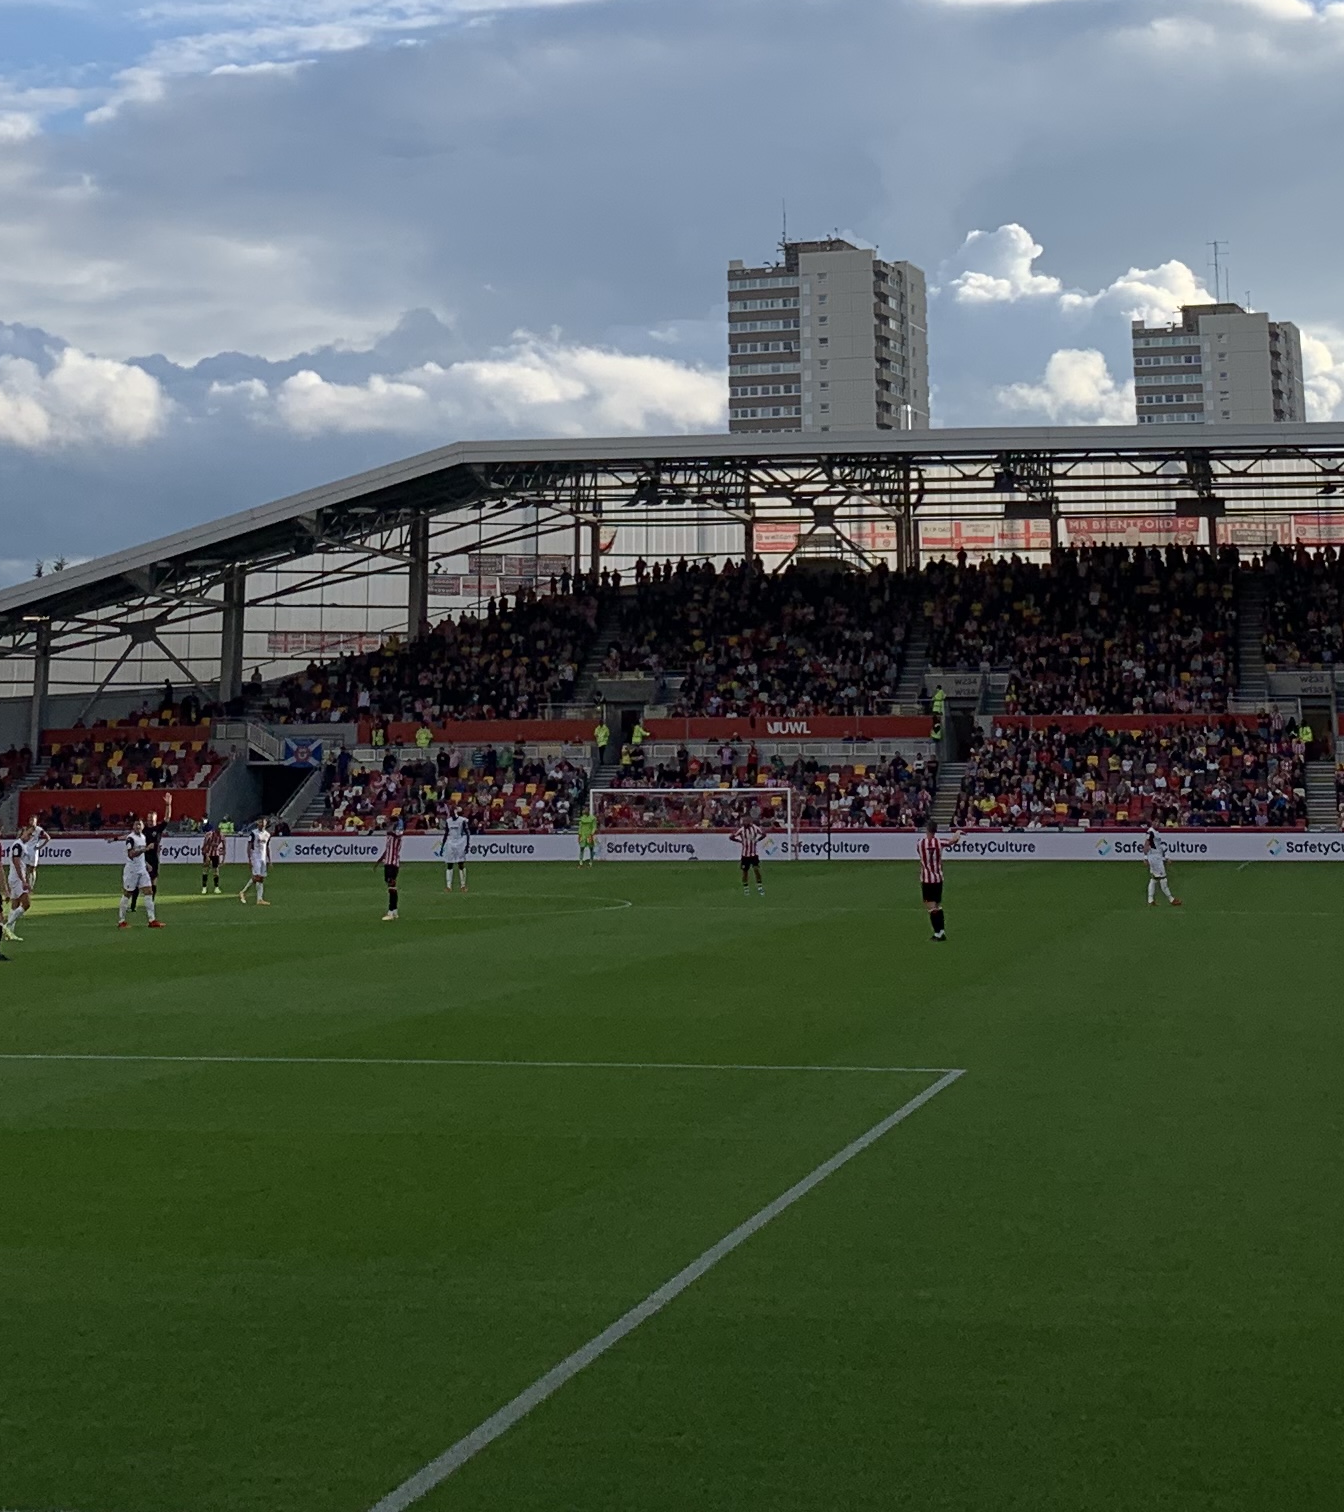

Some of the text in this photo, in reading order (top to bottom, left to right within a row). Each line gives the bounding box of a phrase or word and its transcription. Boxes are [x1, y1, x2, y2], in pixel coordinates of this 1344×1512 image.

[1069, 518, 1194, 530] MR BRENTFORD FC
[295, 844, 378, 857] SafetyCulture
[606, 842, 693, 855] SafetyCulture
[1114, 841, 1207, 854] SafeCulture
